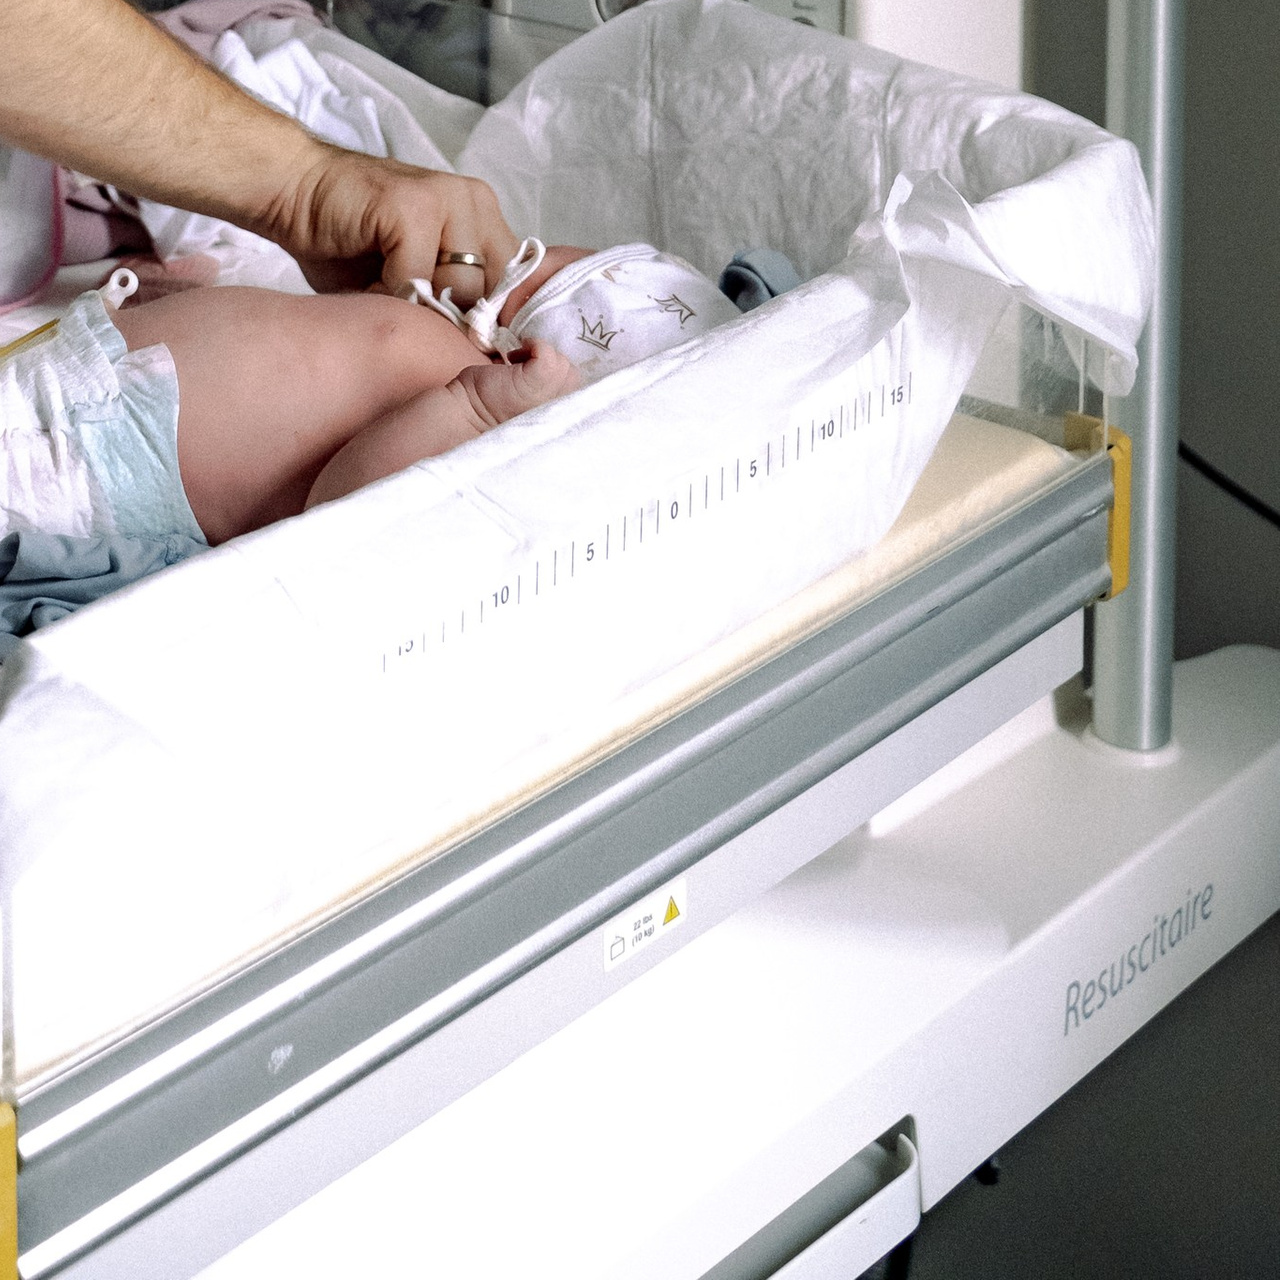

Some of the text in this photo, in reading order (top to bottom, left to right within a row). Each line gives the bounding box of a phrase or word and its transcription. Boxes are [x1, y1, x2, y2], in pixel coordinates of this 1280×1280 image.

[493, 586, 509, 607] 10
[587, 542, 594, 561] 5
[671, 501, 678, 519] 0
[750, 459, 757, 477] 5
[821, 420, 834, 440] 10
[891, 385, 904, 405] 15
[631, 932, 643, 947] (10
[633, 919, 641, 931] 22
[1064, 883, 1214, 1037] Resuscitaire
